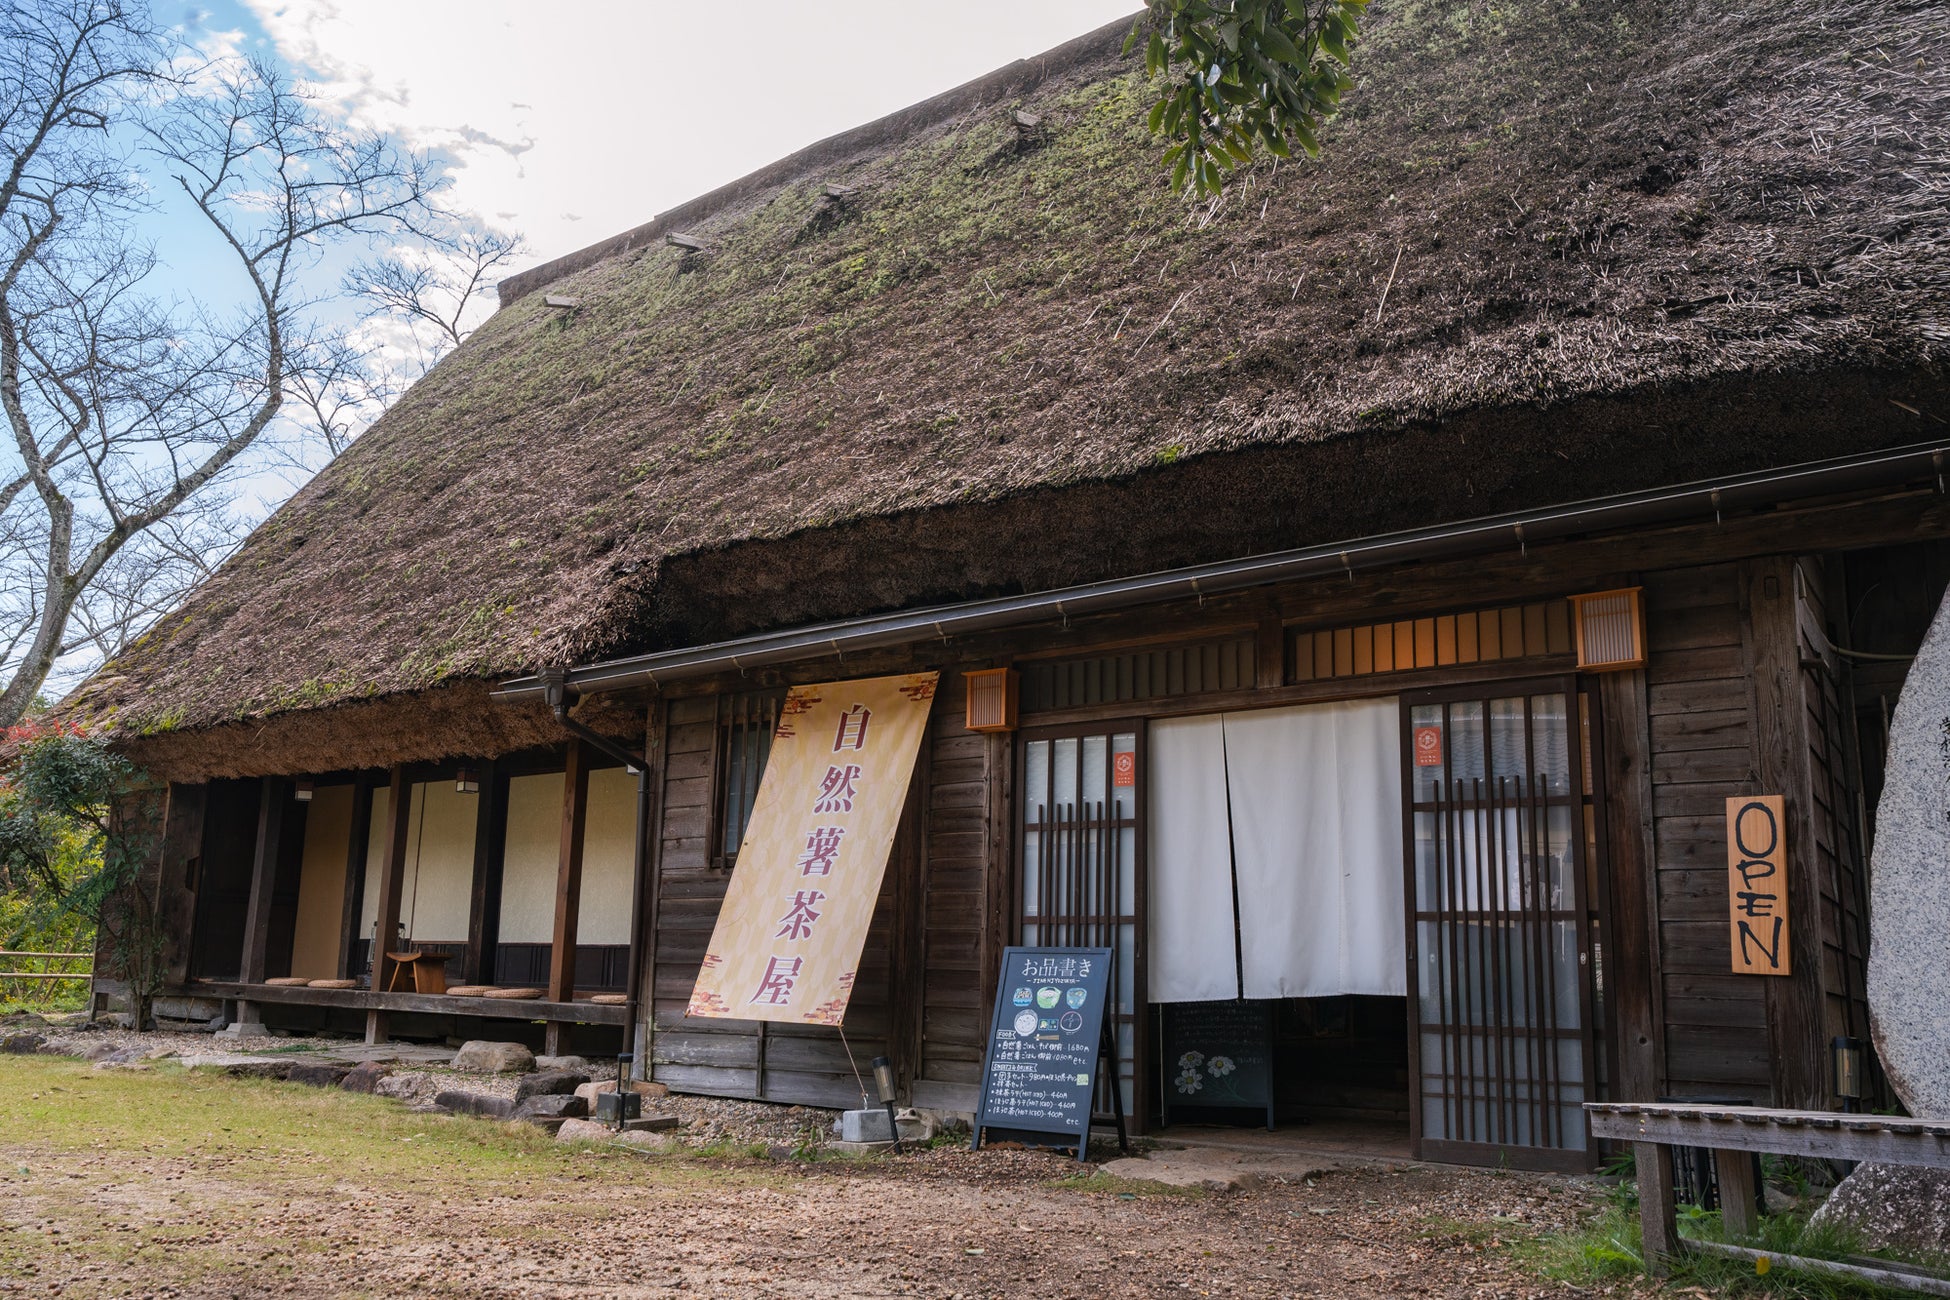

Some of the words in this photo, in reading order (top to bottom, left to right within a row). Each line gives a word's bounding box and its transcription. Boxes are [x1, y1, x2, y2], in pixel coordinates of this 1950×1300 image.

[750, 703, 873, 1005] 自然薯茶屋
[1735, 802, 1783, 968] OPEN
[1021, 957, 1092, 977] お品書き
